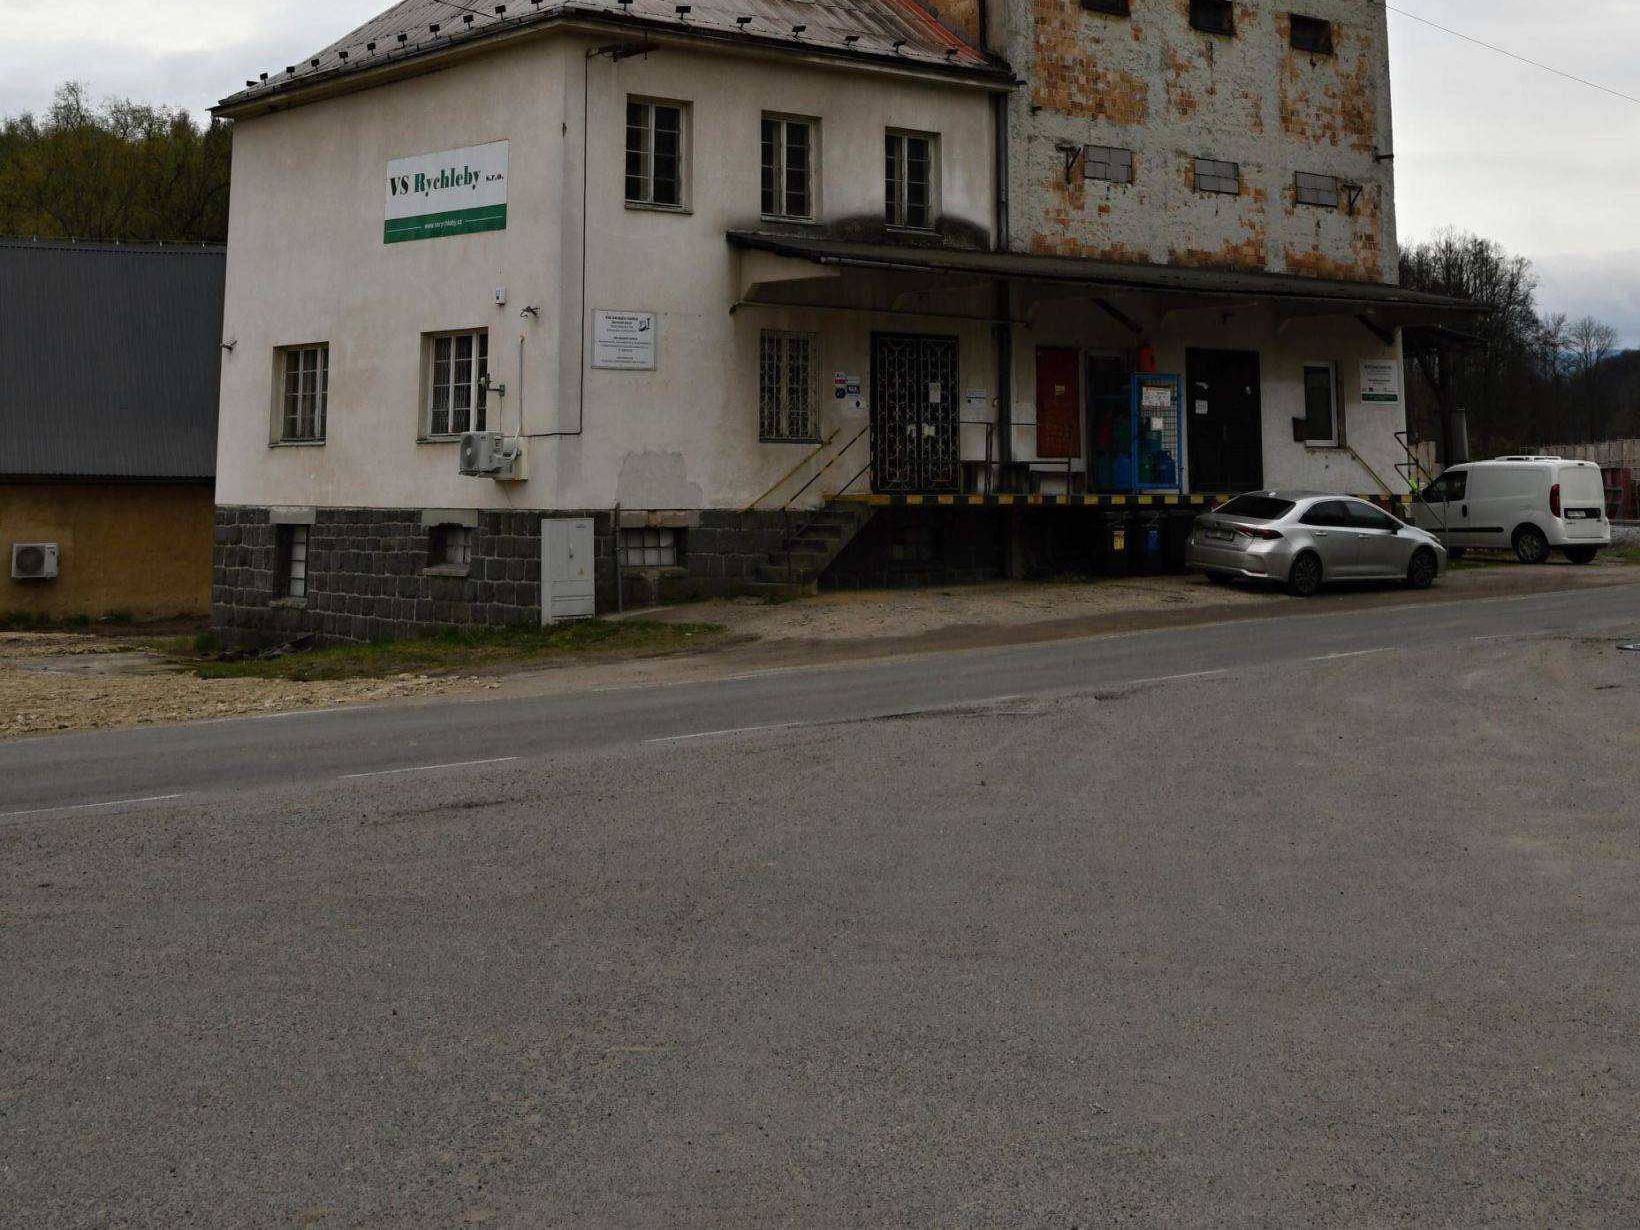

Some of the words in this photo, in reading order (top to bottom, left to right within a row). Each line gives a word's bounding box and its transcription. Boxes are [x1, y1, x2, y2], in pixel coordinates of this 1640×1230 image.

[389, 174, 410, 197] VS
[413, 165, 481, 198] Rychleby
[486, 173, 504, 182] s.r.o.
